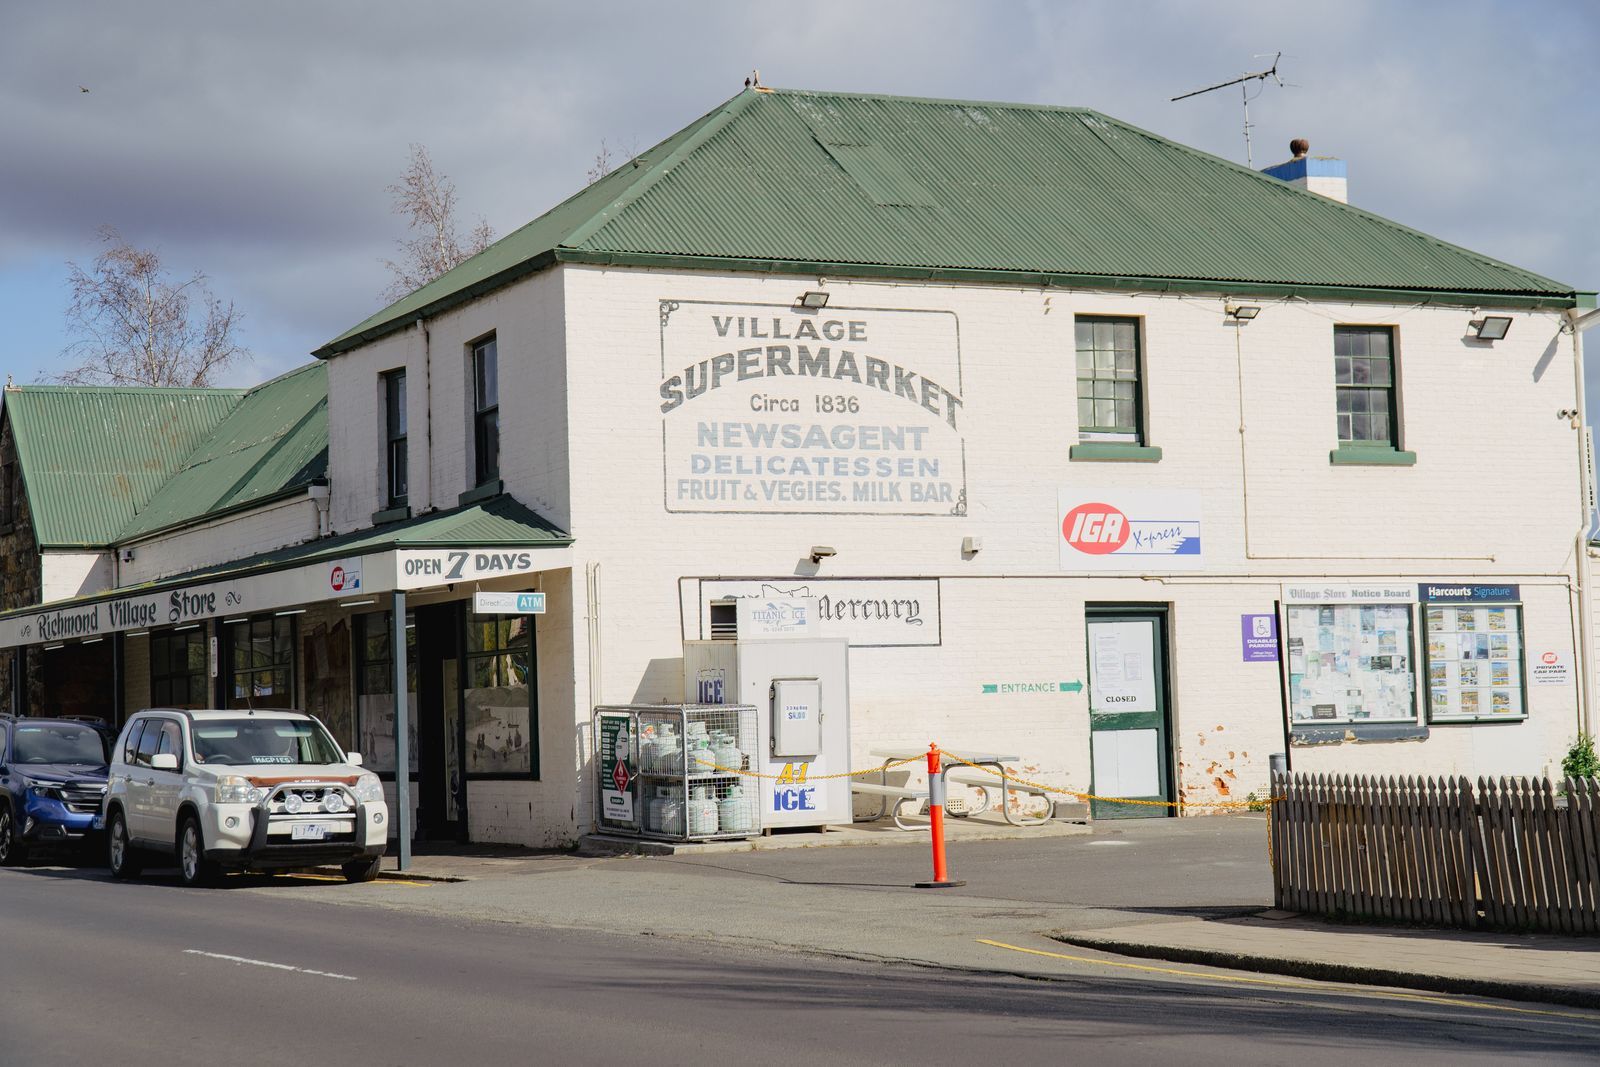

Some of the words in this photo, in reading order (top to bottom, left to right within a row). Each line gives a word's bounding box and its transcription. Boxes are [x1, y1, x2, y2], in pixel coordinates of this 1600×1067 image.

[712, 316, 868, 342] VILLAGE
[660, 345, 963, 432] SUPERMARKET
[750, 394, 799, 412] Circa
[816, 394, 860, 413] 1836
[697, 421, 929, 450] NEWSAGENT
[691, 454, 939, 477] DELICATESSEN
[677, 479, 742, 500] FRUIT
[743, 486, 758, 500] &
[760, 480, 847, 501] VEGIES.
[853, 481, 902, 502] MILK
[910, 482, 952, 503] BAR
[1069, 512, 1124, 544] IGA
[1133, 526, 1183, 549] X-press
[405, 558, 441, 576] OPEN
[445, 552, 469, 579] 7
[475, 553, 531, 570] DAYS
[520, 597, 543, 607] ATM
[1351, 589, 1381, 598] Notice
[1384, 589, 1411, 598] Board
[1428, 586, 1472, 596] Harcourts
[1474, 587, 1510, 597] Signature
[37, 608, 98, 640] Richmond
[109, 599, 156, 627] Village
[168, 590, 216, 623] Store
[752, 611, 786, 620] TITANIC
[792, 611, 806, 619] ICE
[698, 679, 723, 704] ICE
[1001, 682, 1056, 693] ENTRANCE
[1105, 695, 1137, 703] CLOSED
[776, 762, 809, 785] A-1
[773, 787, 816, 812] ICE
